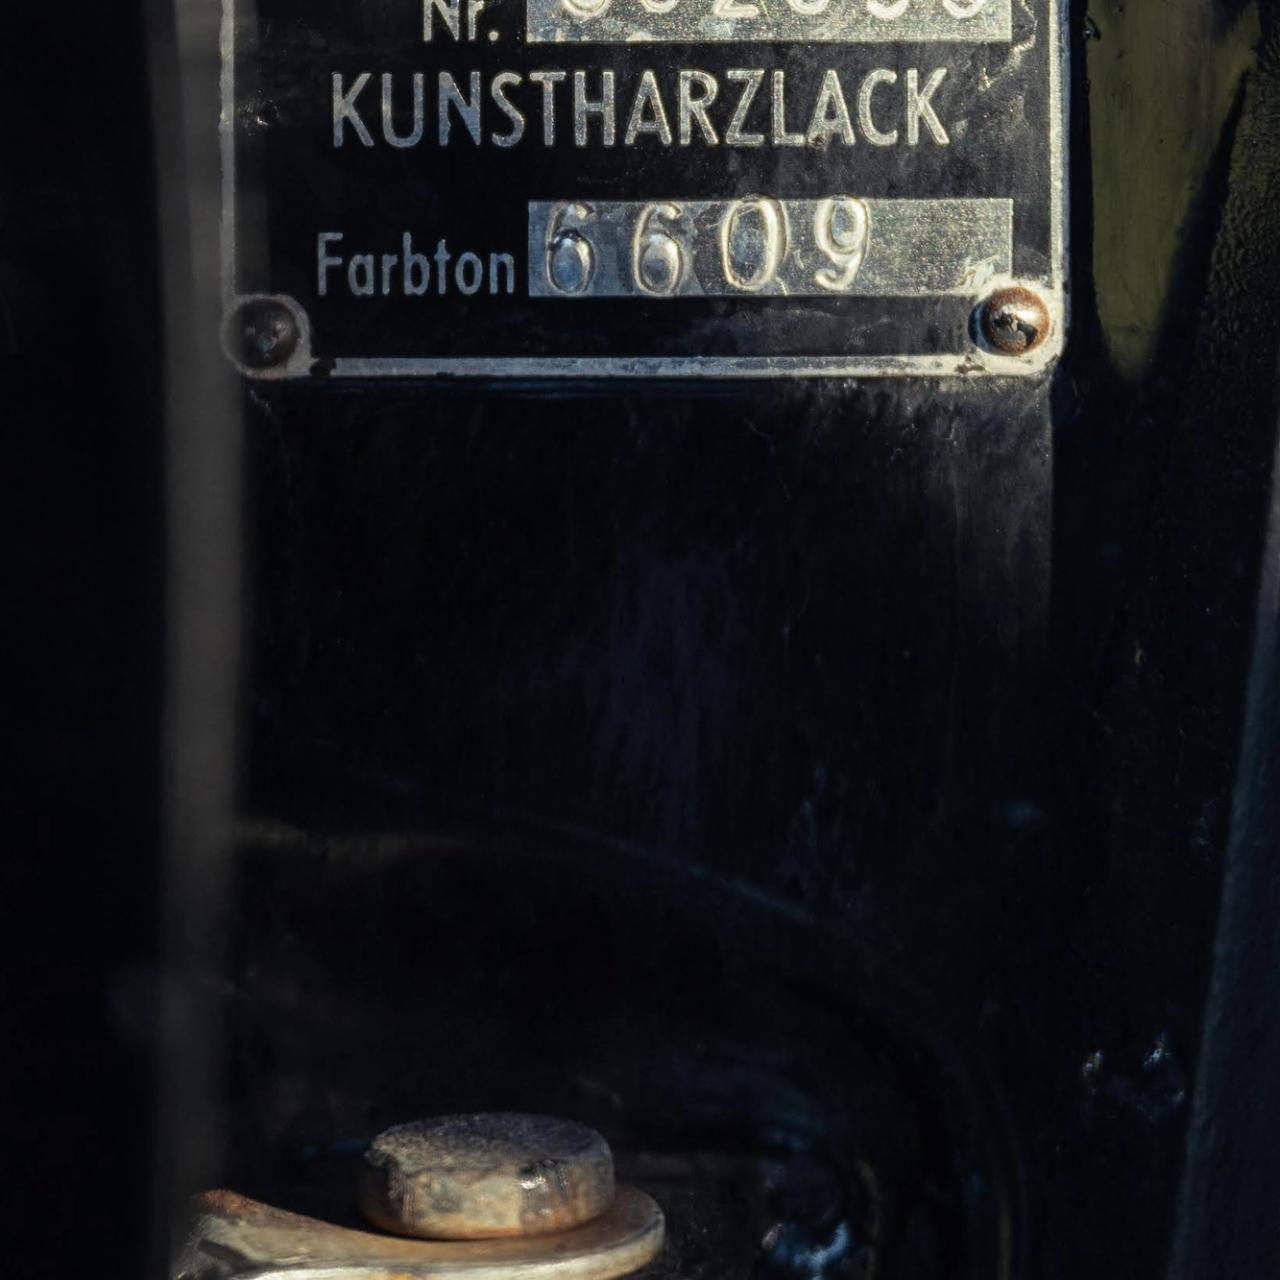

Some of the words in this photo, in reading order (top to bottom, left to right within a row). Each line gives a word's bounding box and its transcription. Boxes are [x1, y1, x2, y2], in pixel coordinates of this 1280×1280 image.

[331, 67, 951, 149] KUNSTHARZLACK
[317, 231, 516, 297] Farbton
[545, 194, 871, 297] 6609
